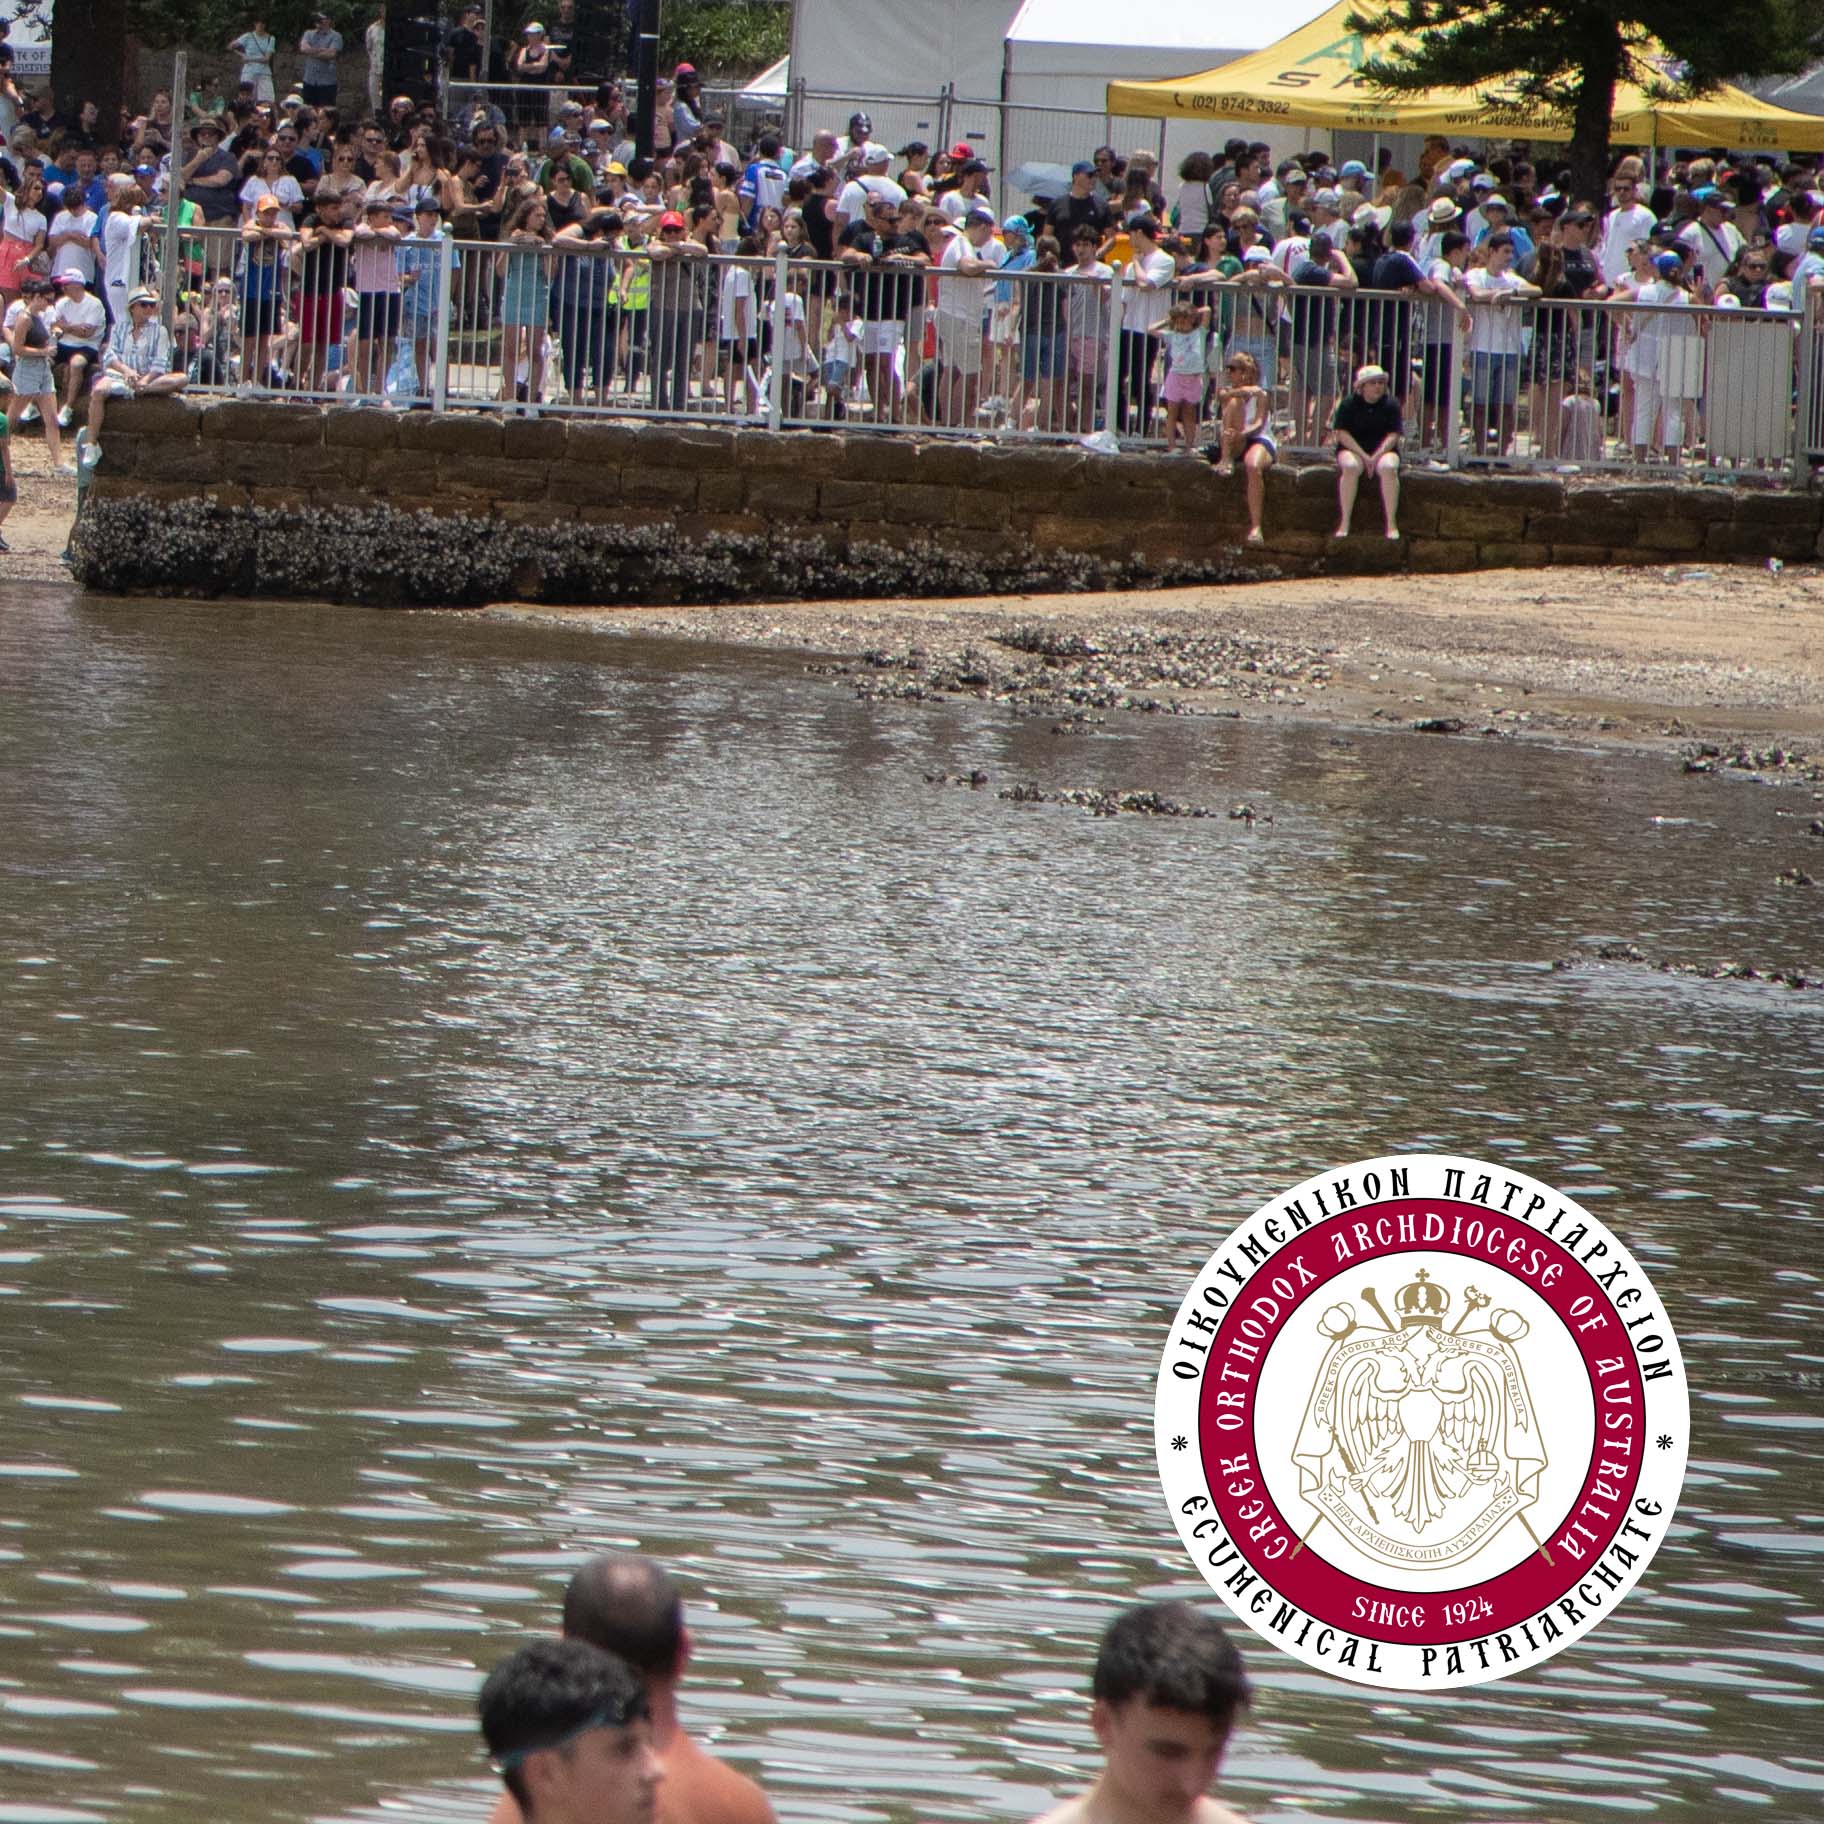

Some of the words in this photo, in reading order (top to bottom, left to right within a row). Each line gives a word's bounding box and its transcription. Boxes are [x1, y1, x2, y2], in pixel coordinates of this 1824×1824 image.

[1191, 94, 1217, 113] (02)
[1220, 98, 1254, 114] 9742
[1256, 99, 1291, 115] 3322
